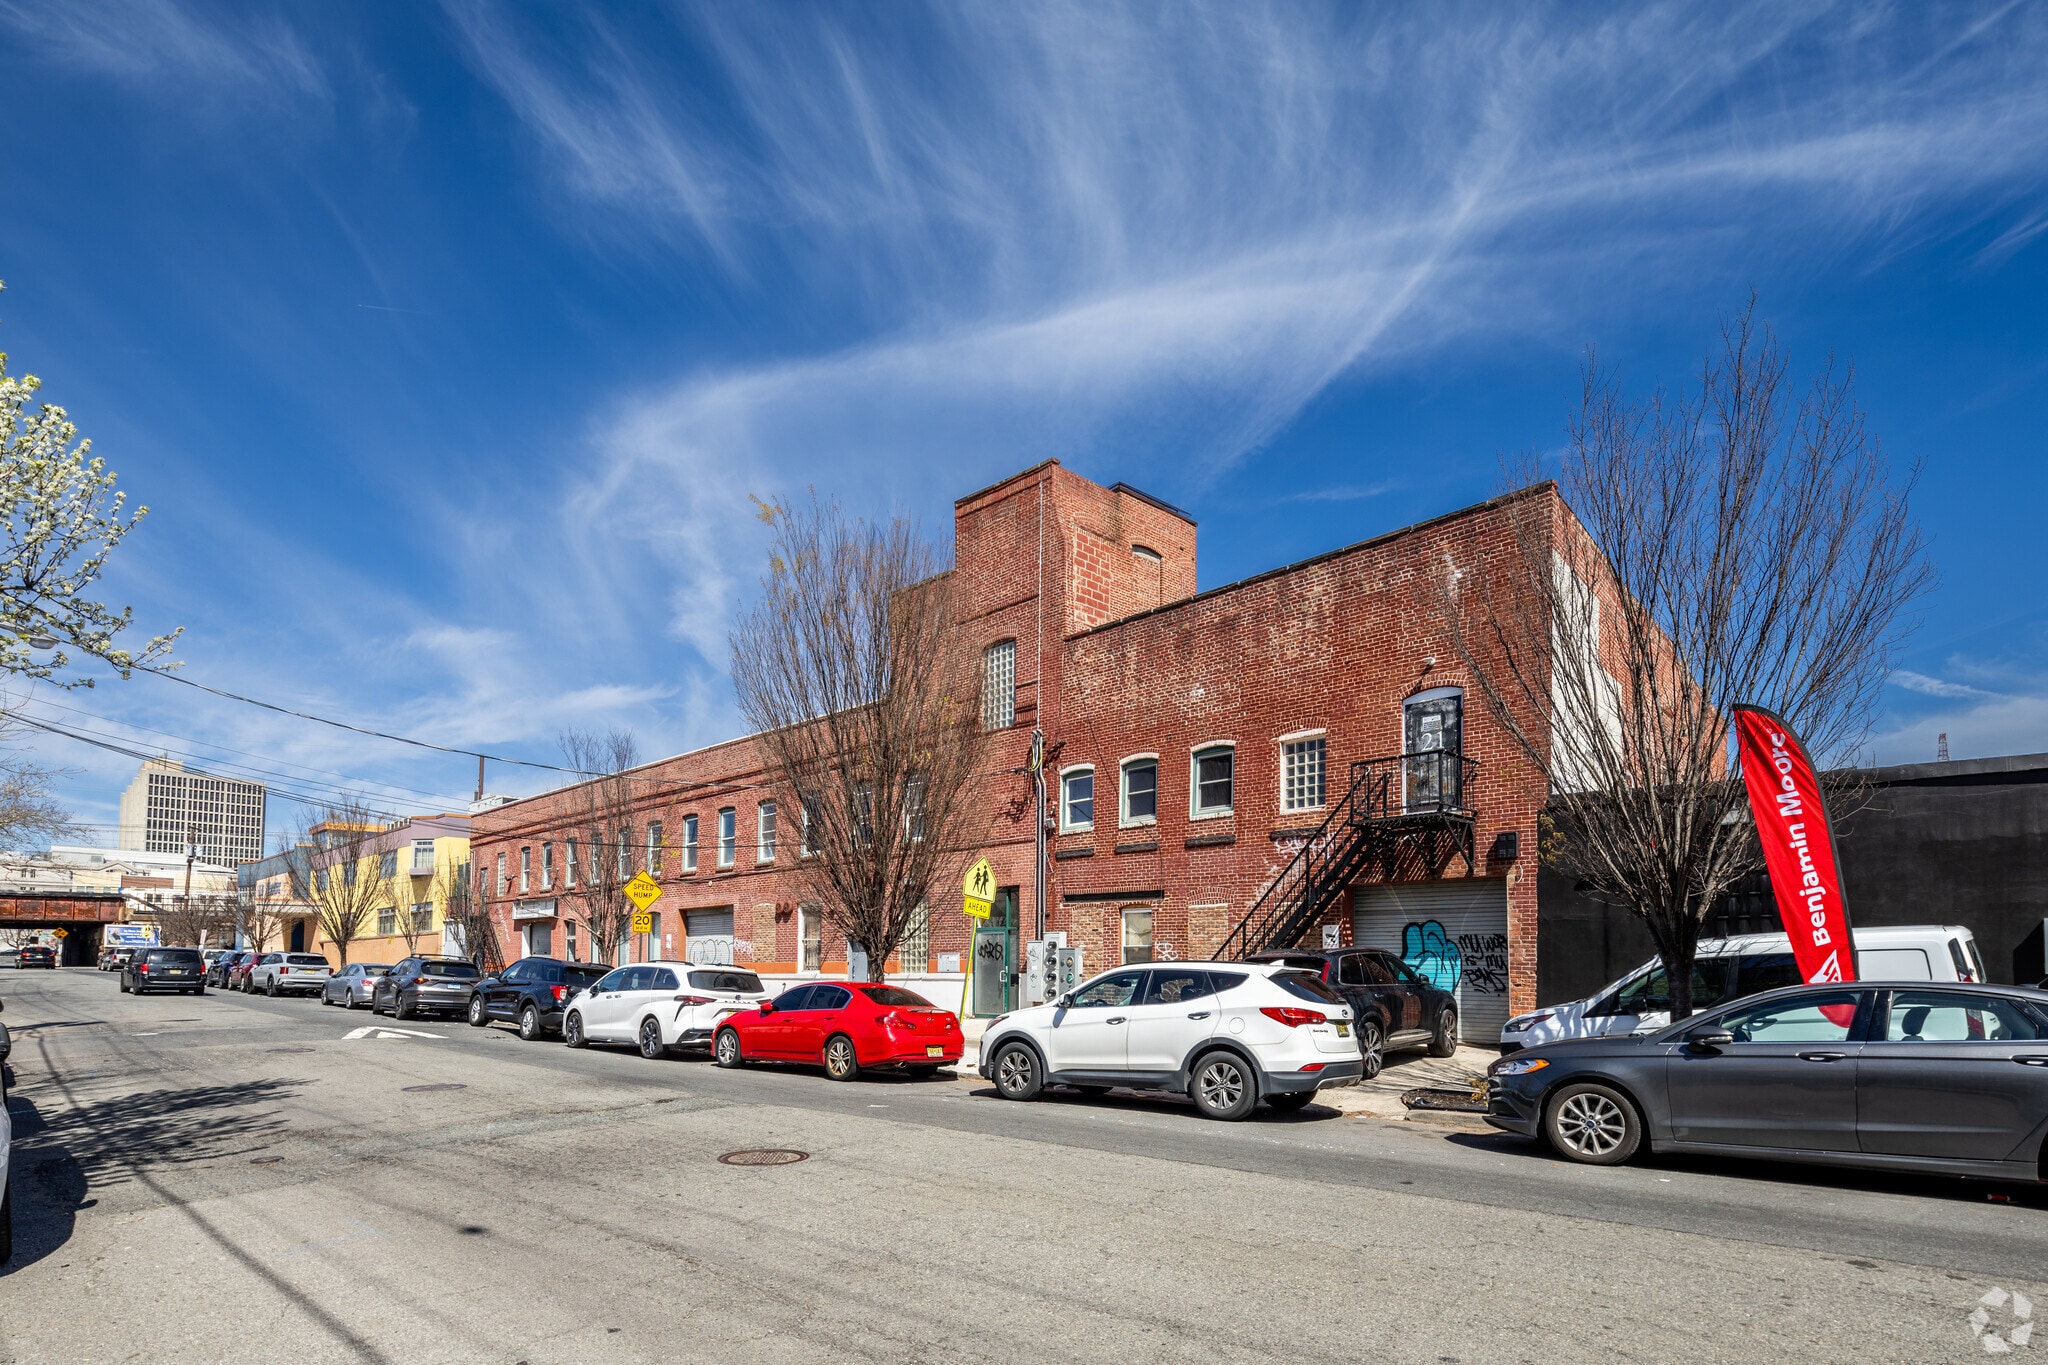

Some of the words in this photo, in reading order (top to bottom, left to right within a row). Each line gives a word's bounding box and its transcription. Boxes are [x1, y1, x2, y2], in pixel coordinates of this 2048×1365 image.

[1421, 730, 1445, 751] 21
[1771, 732, 1803, 817] Moore
[633, 883, 654, 891] SPEED
[1789, 822, 1831, 947] Benjamin
[633, 891, 653, 899] HUMP
[968, 902, 988, 913] AHEAD
[634, 915, 650, 926] 20
